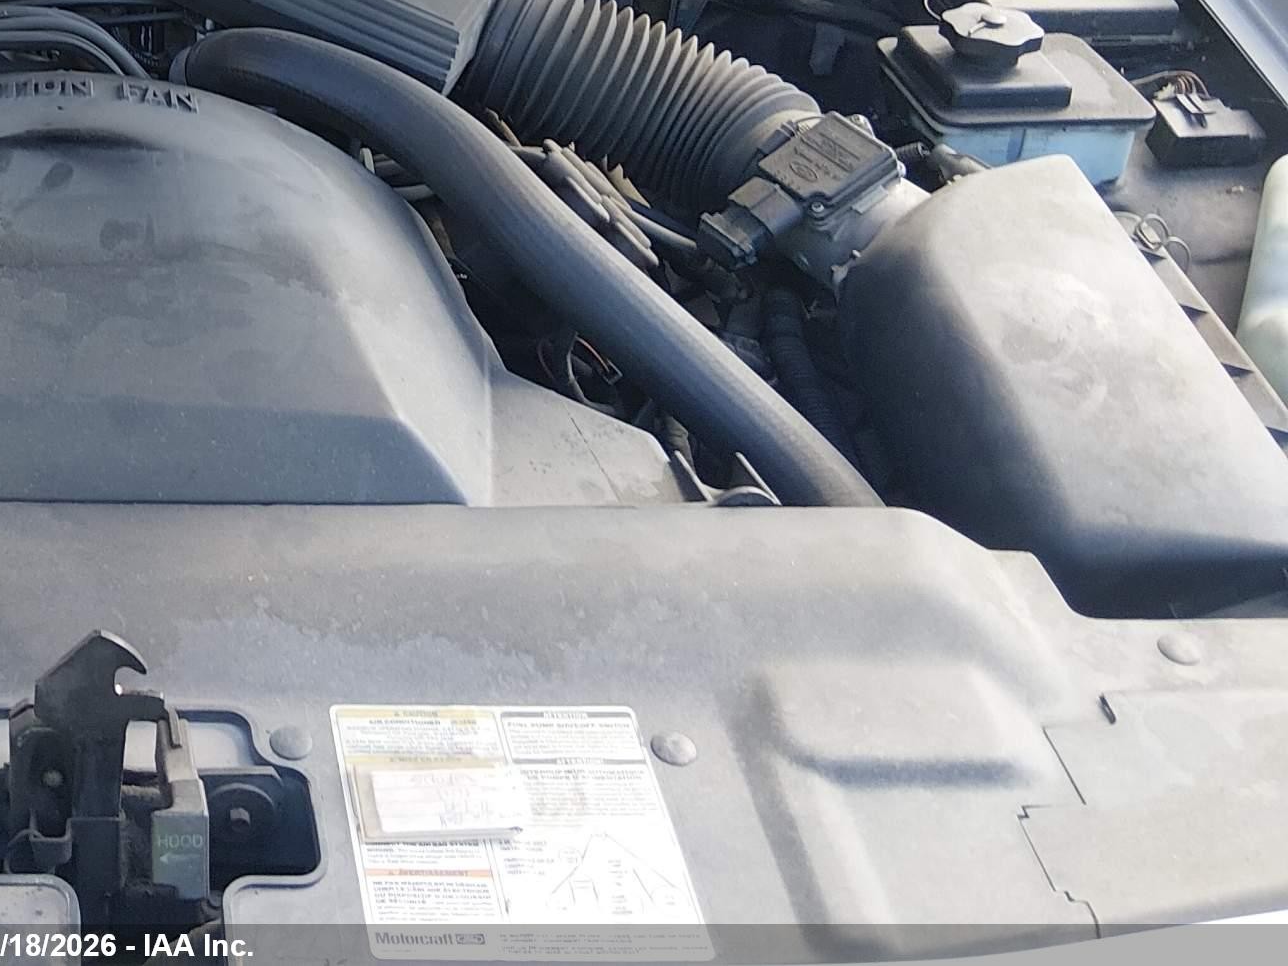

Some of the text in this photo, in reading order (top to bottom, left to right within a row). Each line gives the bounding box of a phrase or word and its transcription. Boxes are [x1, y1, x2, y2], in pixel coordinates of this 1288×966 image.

[120, 79, 201, 114] FAN
[158, 834, 203, 848] HOOD
[375, 932, 454, 945] Motorcraft
